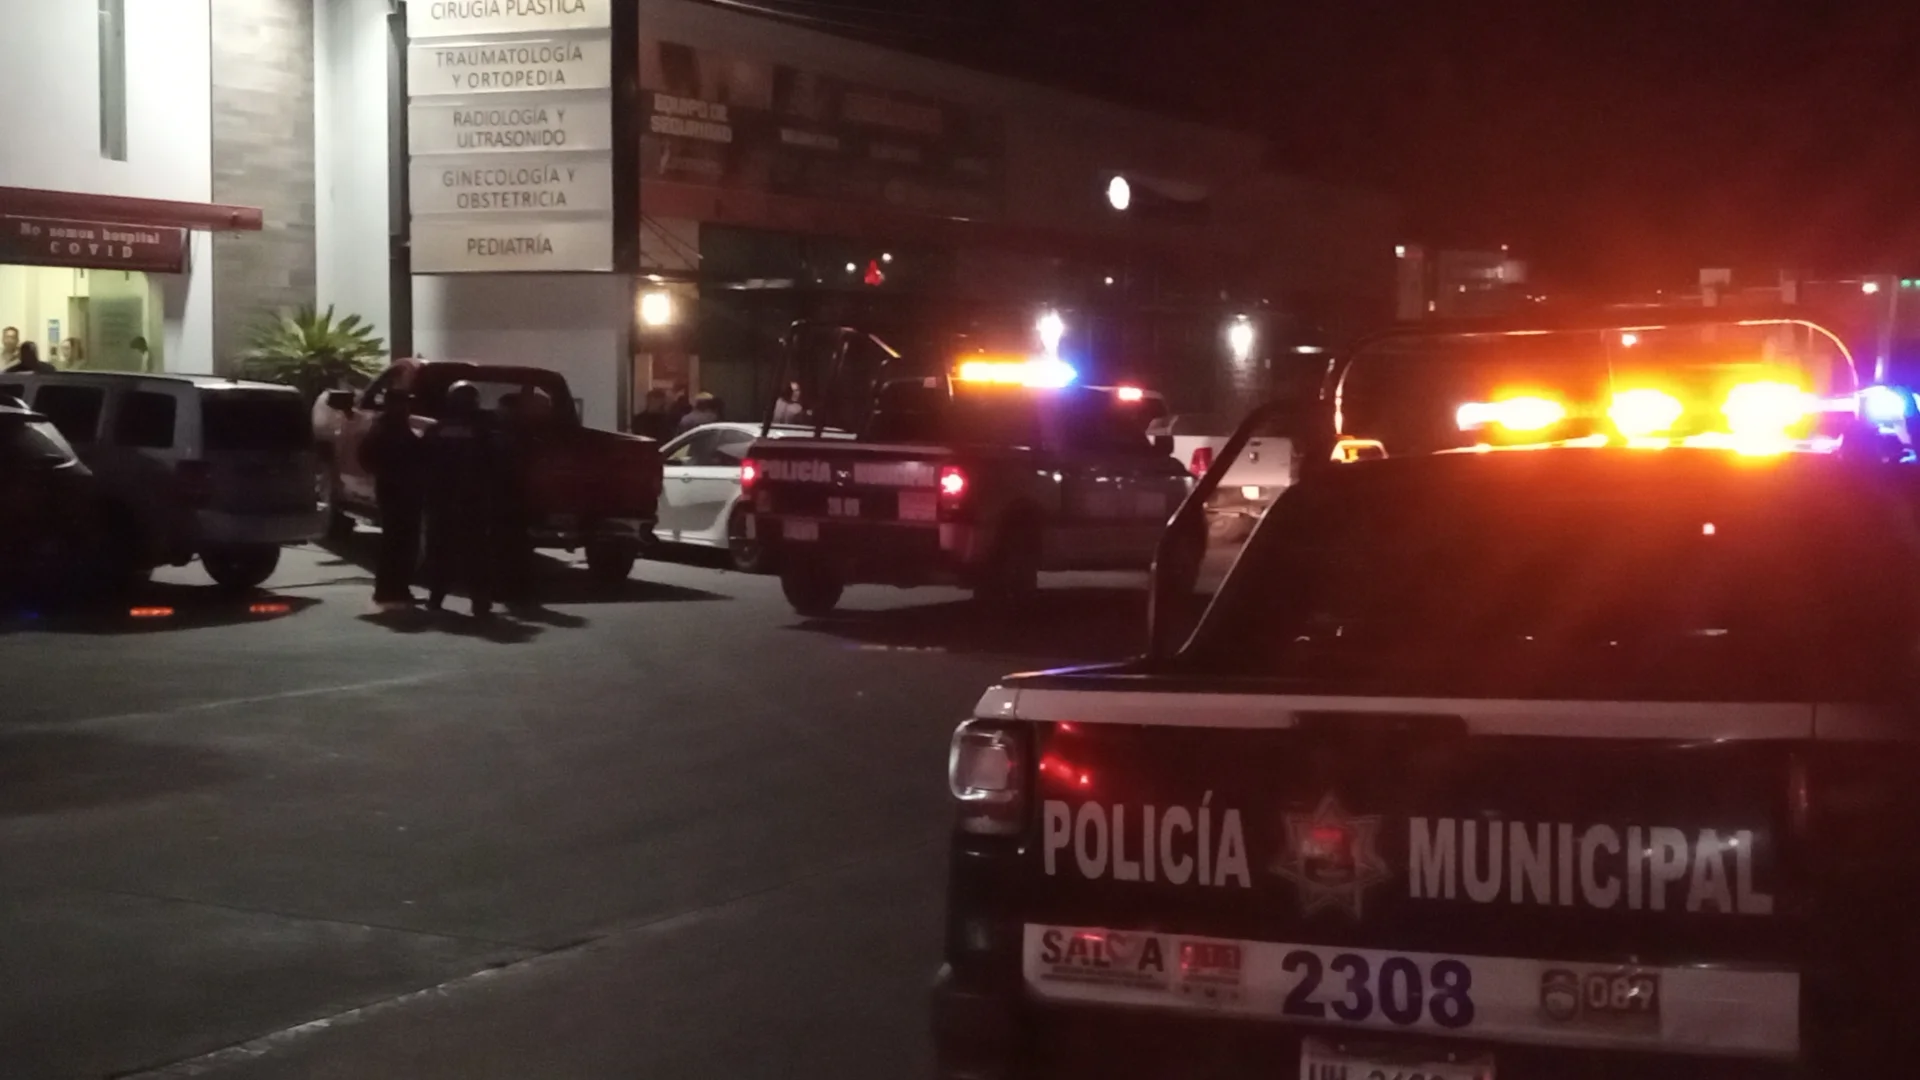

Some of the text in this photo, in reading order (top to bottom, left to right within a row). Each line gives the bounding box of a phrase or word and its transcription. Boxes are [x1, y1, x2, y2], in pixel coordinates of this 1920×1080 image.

[435, 42, 583, 68] TRAUMATOLOGÍA
[452, 69, 566, 89] Y ORTOPEDIA
[453, 104, 566, 127] RADIOLOGÍA Y
[456, 129, 567, 149] ULTRASONIDO
[442, 164, 576, 187] GINECOLOGÍA Y
[456, 190, 568, 209] OBSTETRICIA
[20, 221, 42, 236] No
[102, 228, 161, 246] hospital
[466, 233, 554, 256] PEDIATRÍA
[1043, 790, 1774, 916] POLICÍA MUNICIPAL
[1281, 949, 1475, 1029] 2308
